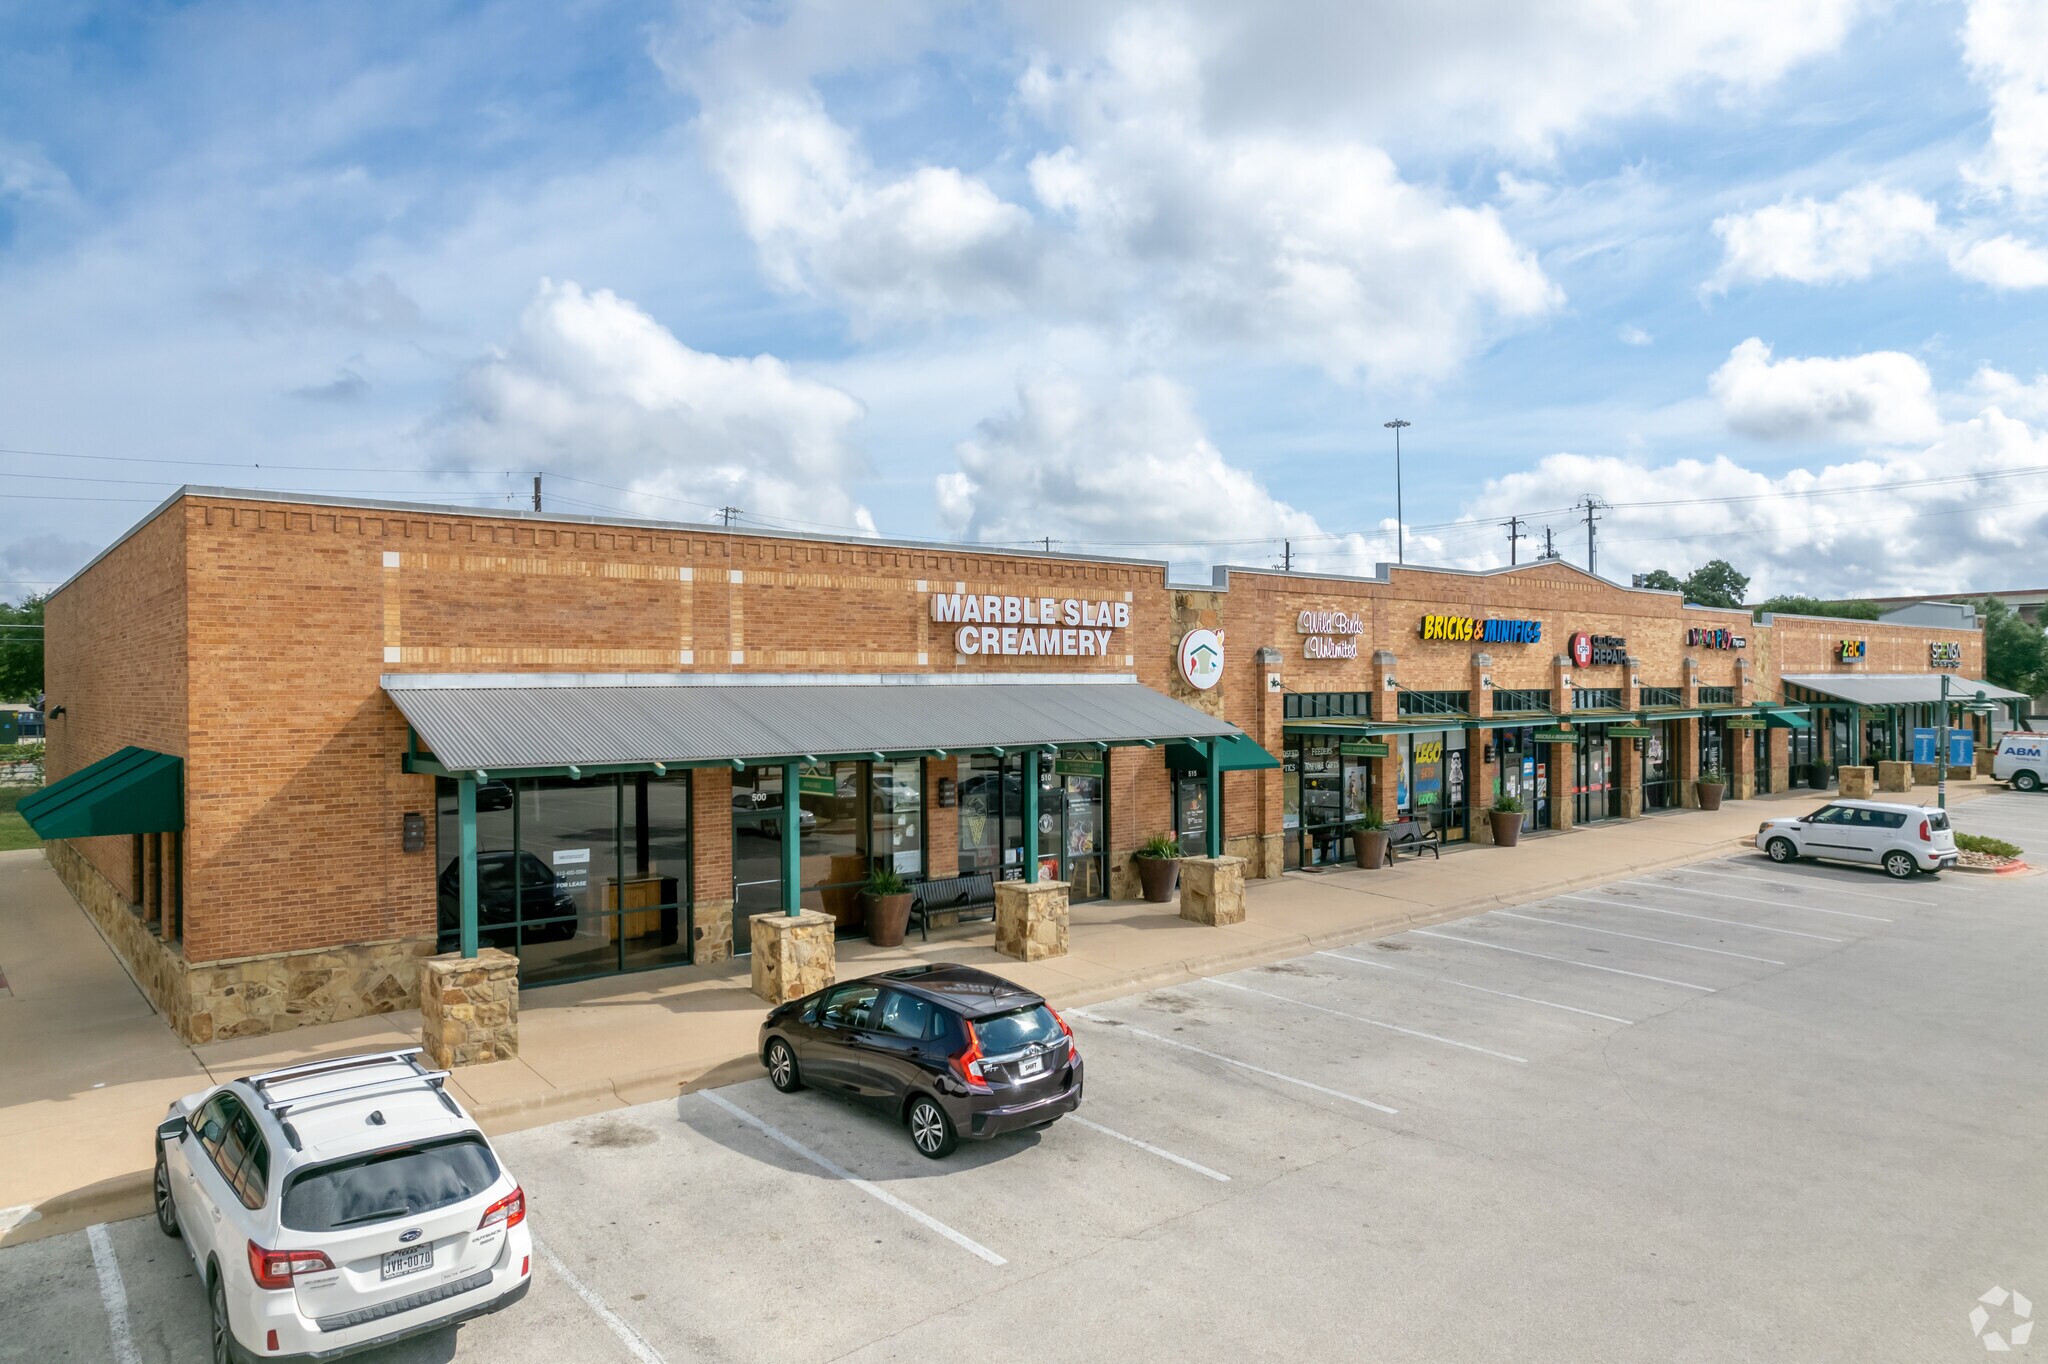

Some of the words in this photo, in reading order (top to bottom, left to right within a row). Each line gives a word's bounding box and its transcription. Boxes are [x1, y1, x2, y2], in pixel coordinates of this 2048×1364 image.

[936, 593, 1057, 625] MARBLE
[1063, 599, 1130, 628] SLAB
[1303, 611, 1332, 634] Wild
[1334, 612, 1364, 634] Birds
[1424, 615, 1473, 641] BRICKS
[1473, 619, 1484, 640] &
[1484, 619, 1541, 643] MINIFIGS
[958, 625, 1113, 656] CREAMERY
[1593, 635, 1606, 647] CELL
[1309, 636, 1358, 659] Unlimited
[1932, 642, 1961, 660] SPENGA
[1593, 648, 1627, 665] REPAIR
[1283, 749, 1299, 758] DSEED
[1311, 747, 1333, 756] FEEDERS
[1415, 741, 1441, 764] LEGO
[2004, 747, 2041, 757] ABM
[1040, 774, 1052, 782] 510
[751, 793, 767, 802] 500
[568, 880, 587, 888] LEASE
[1025, 1062, 1037, 1071] SHIFT
[398, 1248, 418, 1257] TEXAS
